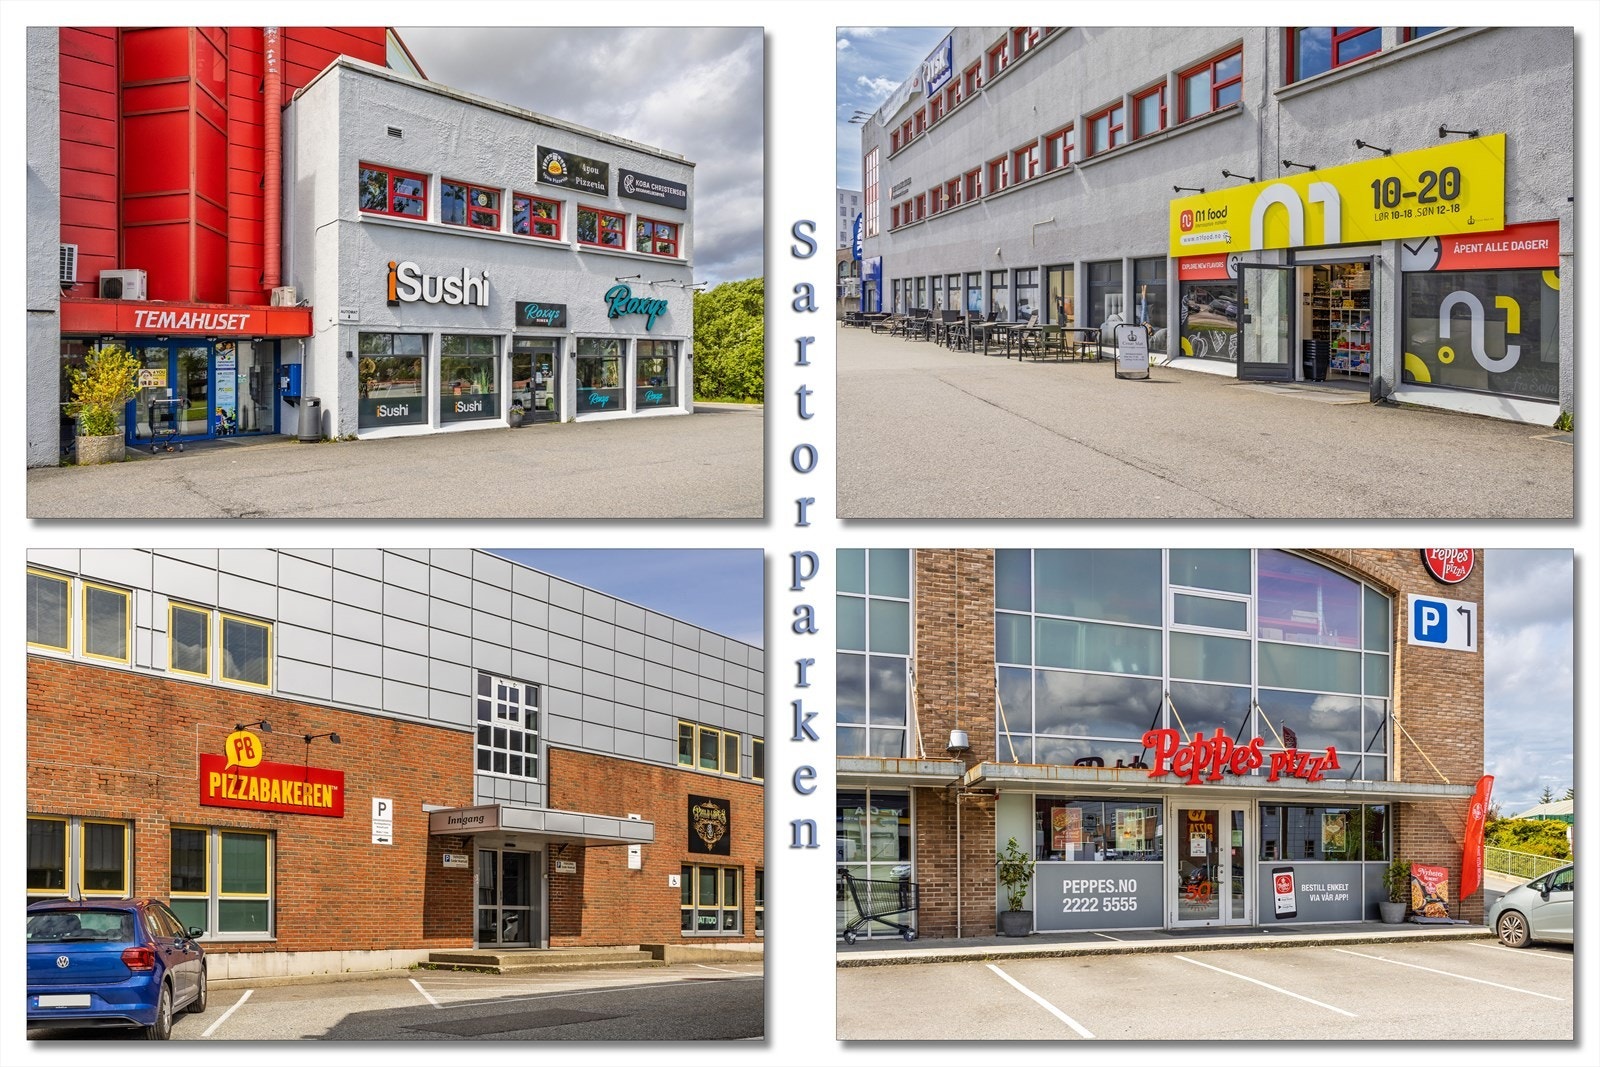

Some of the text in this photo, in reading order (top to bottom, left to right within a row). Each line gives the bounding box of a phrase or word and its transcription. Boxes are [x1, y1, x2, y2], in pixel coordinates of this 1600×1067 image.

[575, 177, 605, 191] Pizzeria
[635, 179, 686, 198] KOBA CHRISTENSEN
[1371, 166, 1461, 209] 10-20
[1207, 205, 1228, 221] food
[1374, 211, 1389, 222] LØR
[1391, 208, 1413, 220] 10-18
[1436, 203, 1460, 215] 12-18
[1453, 239, 1549, 254] ÅPENT ALLE DAGER!
[387, 260, 490, 307] iSushi
[524, 303, 560, 326] Roxys
[604, 284, 669, 332] Roxys
[134, 310, 250, 330] TEMAHUSET
[376, 404, 409, 418] iSushi
[455, 400, 482, 413] iSushi
[1422, 606, 1440, 636] P
[233, 736, 255, 762] PB
[1142, 727, 1341, 785] Peppes PIZZA
[378, 801, 387, 816] P
[448, 815, 484, 826] Inngang
[1063, 879, 1137, 893] PEPPES.NO
[1185, 880, 1211, 900] 50
[1301, 883, 1349, 892] BESTILL ENKELT
[1062, 896, 1138, 912] 2222 5555
[1309, 892, 1349, 902] VIA VÅR APP!
